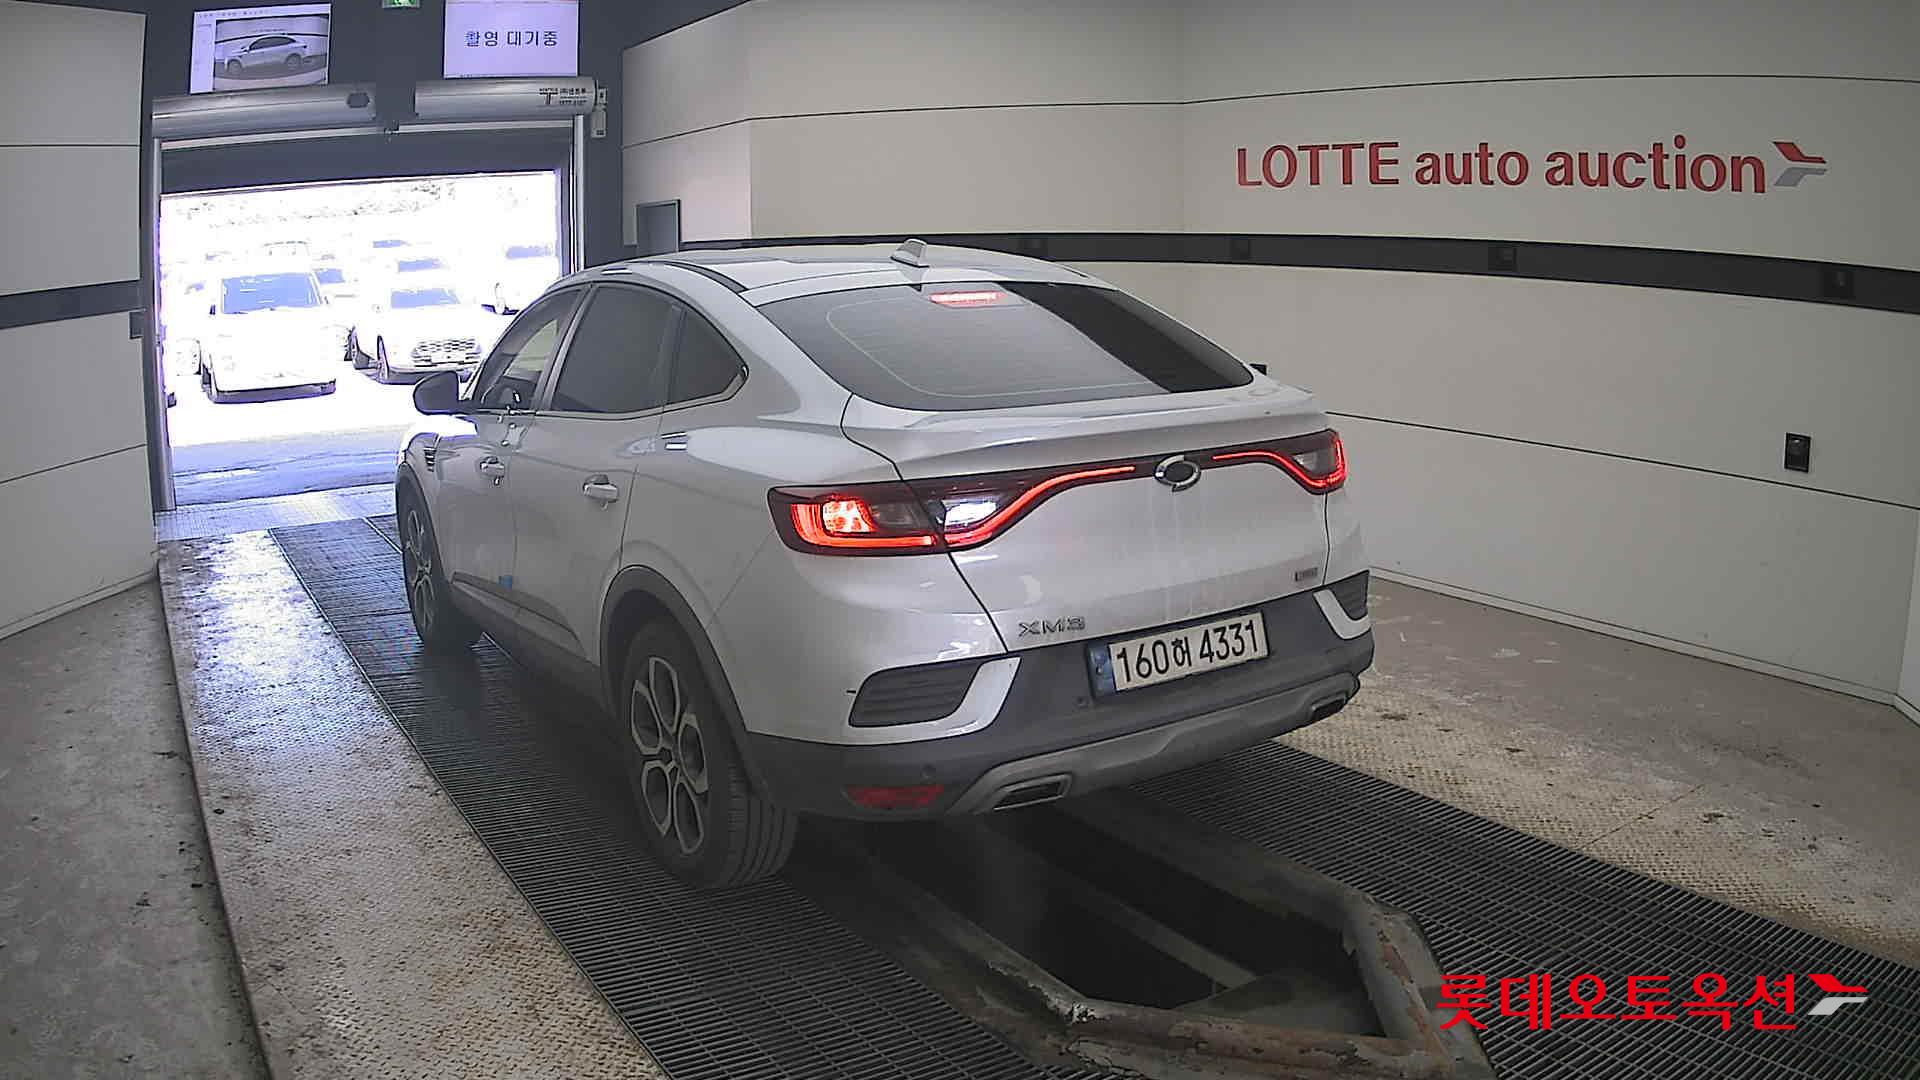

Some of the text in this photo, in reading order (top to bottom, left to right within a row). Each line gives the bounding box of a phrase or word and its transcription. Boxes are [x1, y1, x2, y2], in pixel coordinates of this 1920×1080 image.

[507, 31, 558, 47] 대기중
[1237, 135, 1767, 194] LOTTE auto auction
[1116, 619, 1259, 683] 160허 4331
